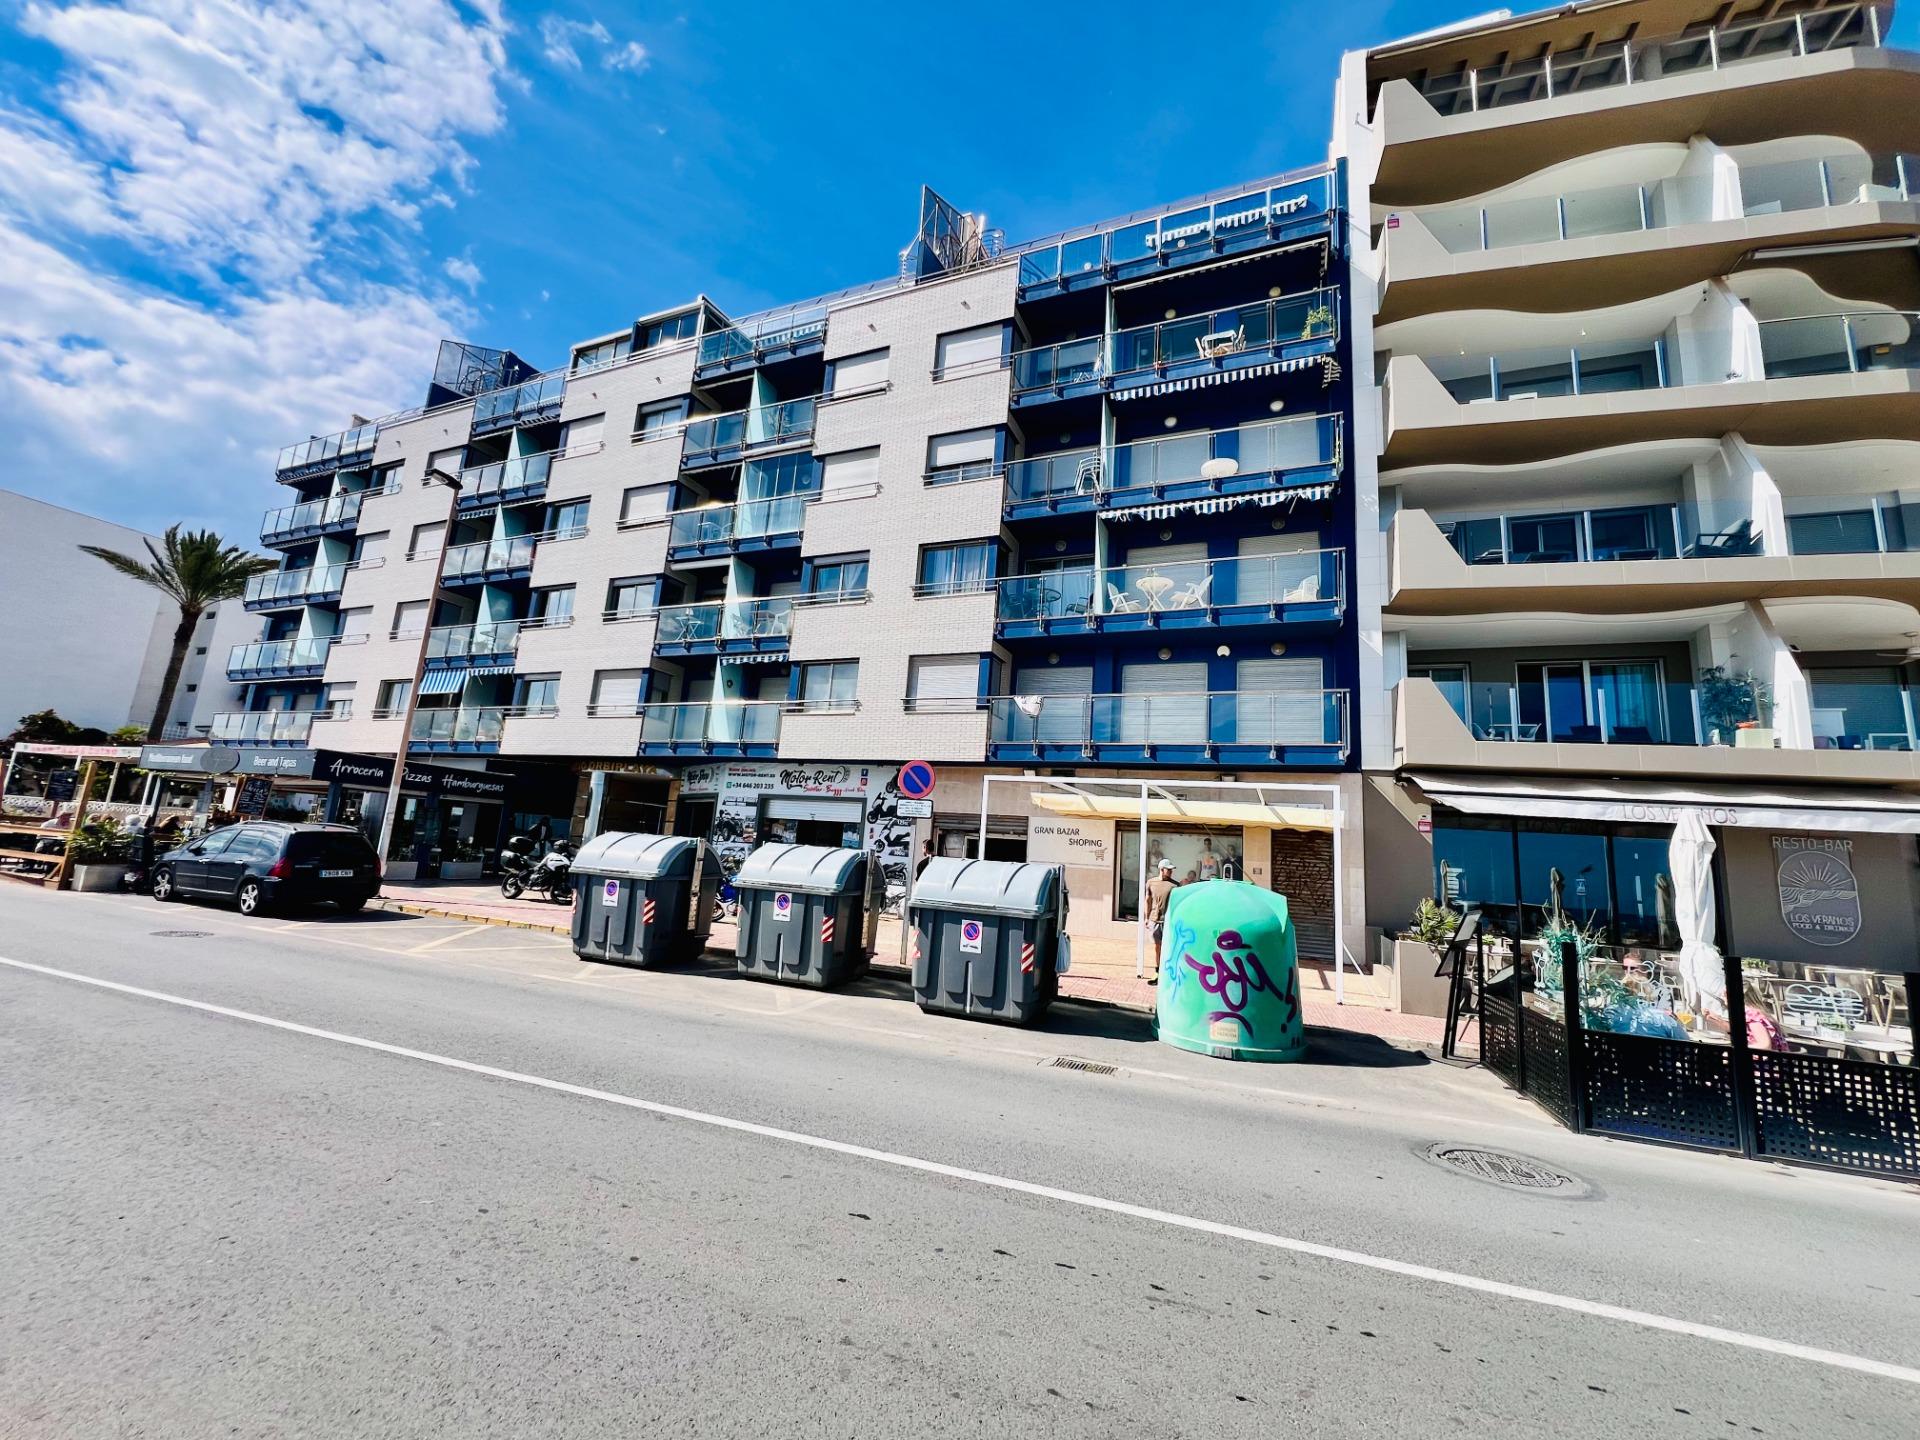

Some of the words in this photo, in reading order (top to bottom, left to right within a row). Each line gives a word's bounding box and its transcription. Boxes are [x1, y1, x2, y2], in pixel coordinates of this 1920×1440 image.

[253, 755, 268, 767] Beer
[267, 756, 279, 767] and
[279, 756, 298, 769] Tapas
[442, 774, 505, 793] Hamburguesas
[780, 768, 812, 790] Motor
[812, 766, 842, 786] Rent
[1622, 804, 1656, 820] LOS
[1034, 826, 1054, 835] GRAN
[1056, 827, 1080, 836] BAZAR
[1068, 838, 1103, 847] SHOPING
[1772, 836, 1854, 853] RESTO-BAR
[1790, 913, 1810, 923] LOS
[1792, 922, 1812, 930] FOOD
[1824, 925, 1855, 933] DRINKS
